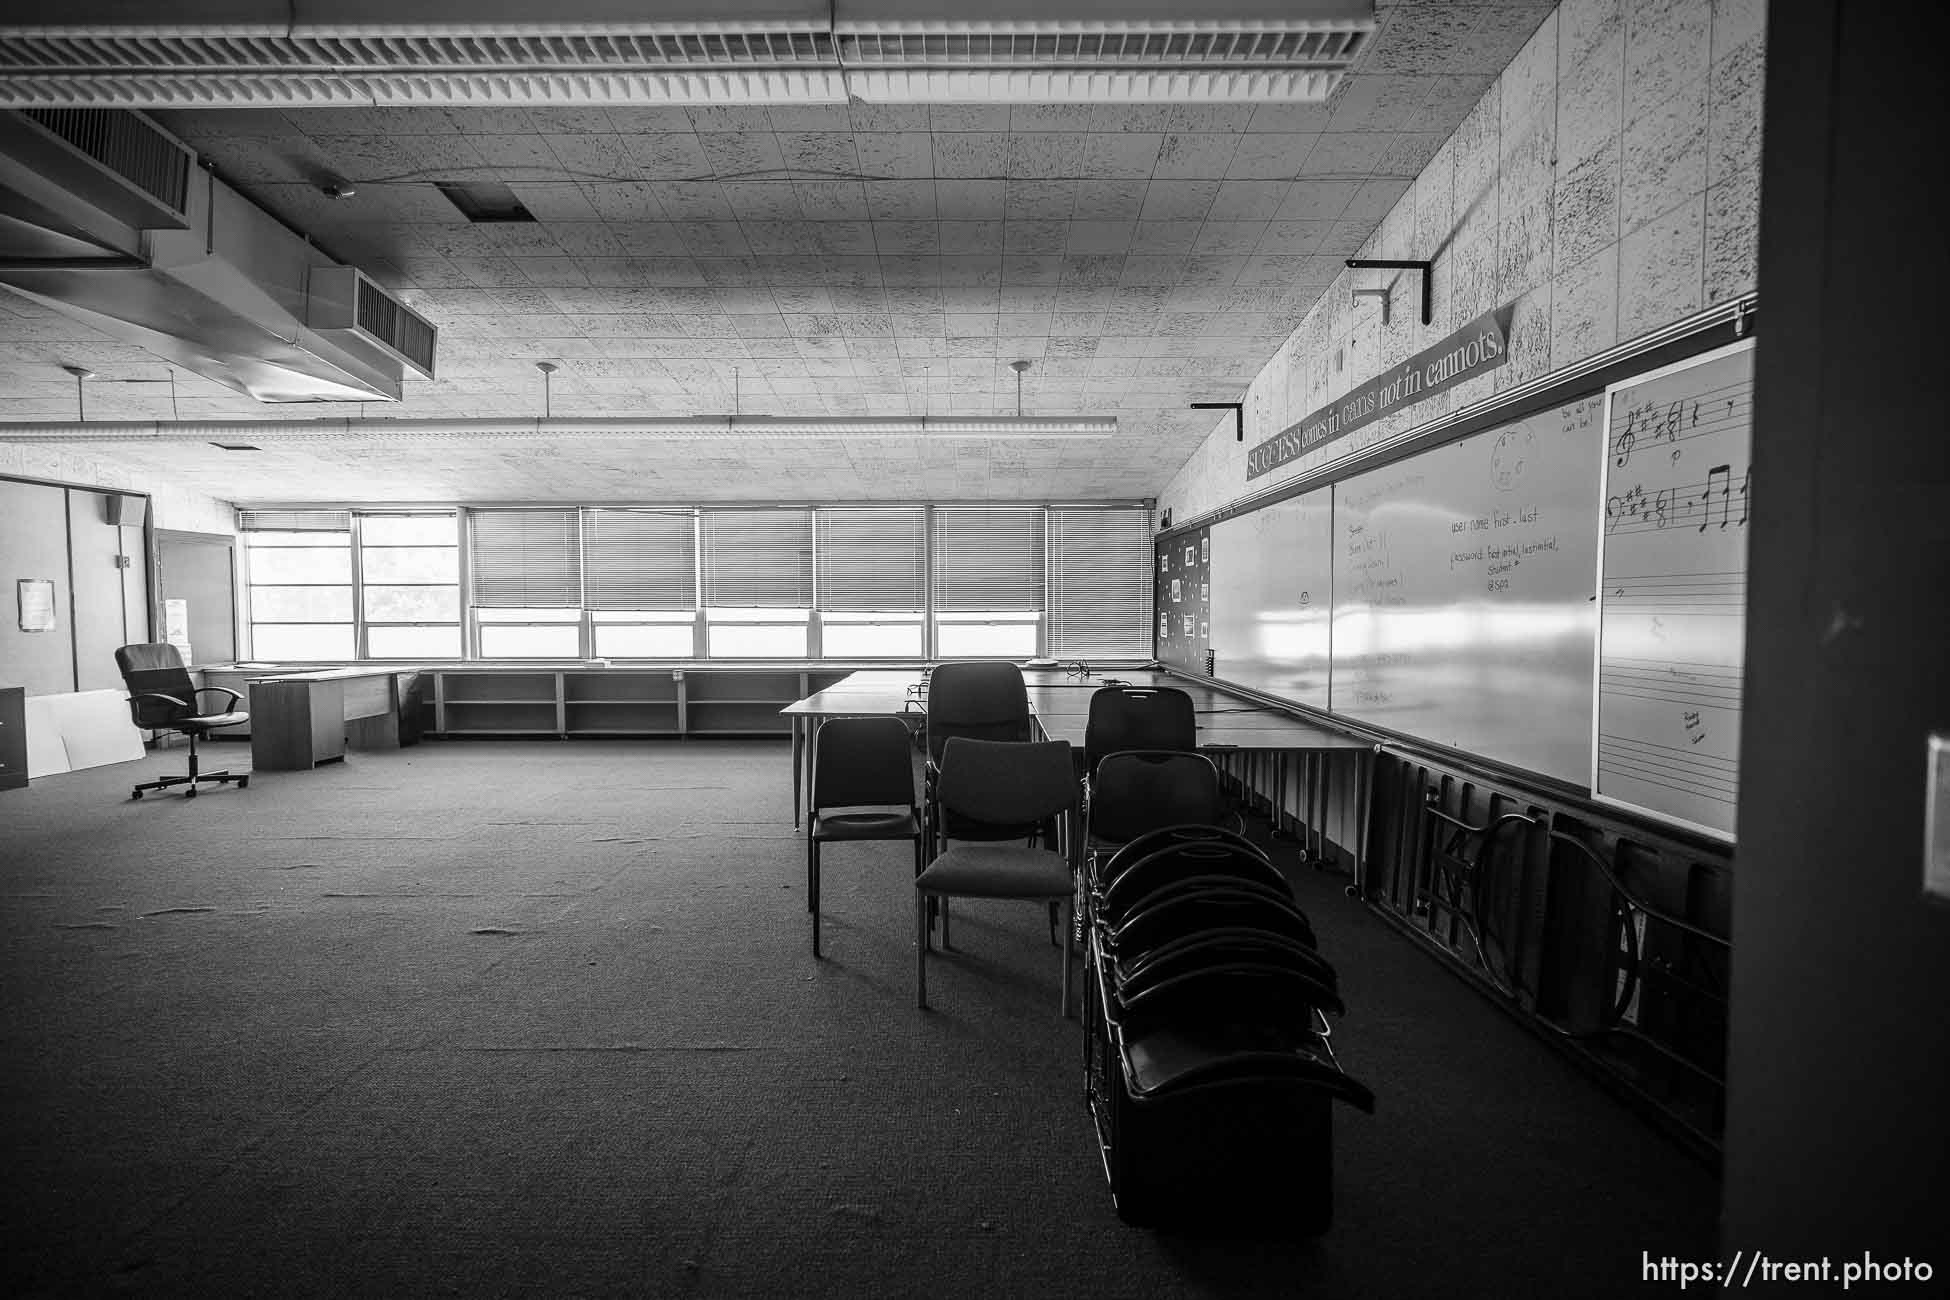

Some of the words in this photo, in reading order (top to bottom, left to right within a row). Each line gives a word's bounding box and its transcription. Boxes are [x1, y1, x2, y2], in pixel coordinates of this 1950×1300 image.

[1249, 428, 1300, 473] SUCCESS
[1302, 419, 1327, 448] comes
[1329, 408, 1340, 434] in
[1343, 392, 1375, 425] cans
[1380, 374, 1402, 409] not
[1405, 366, 1423, 397] in
[1426, 327, 1504, 387] cannots.
